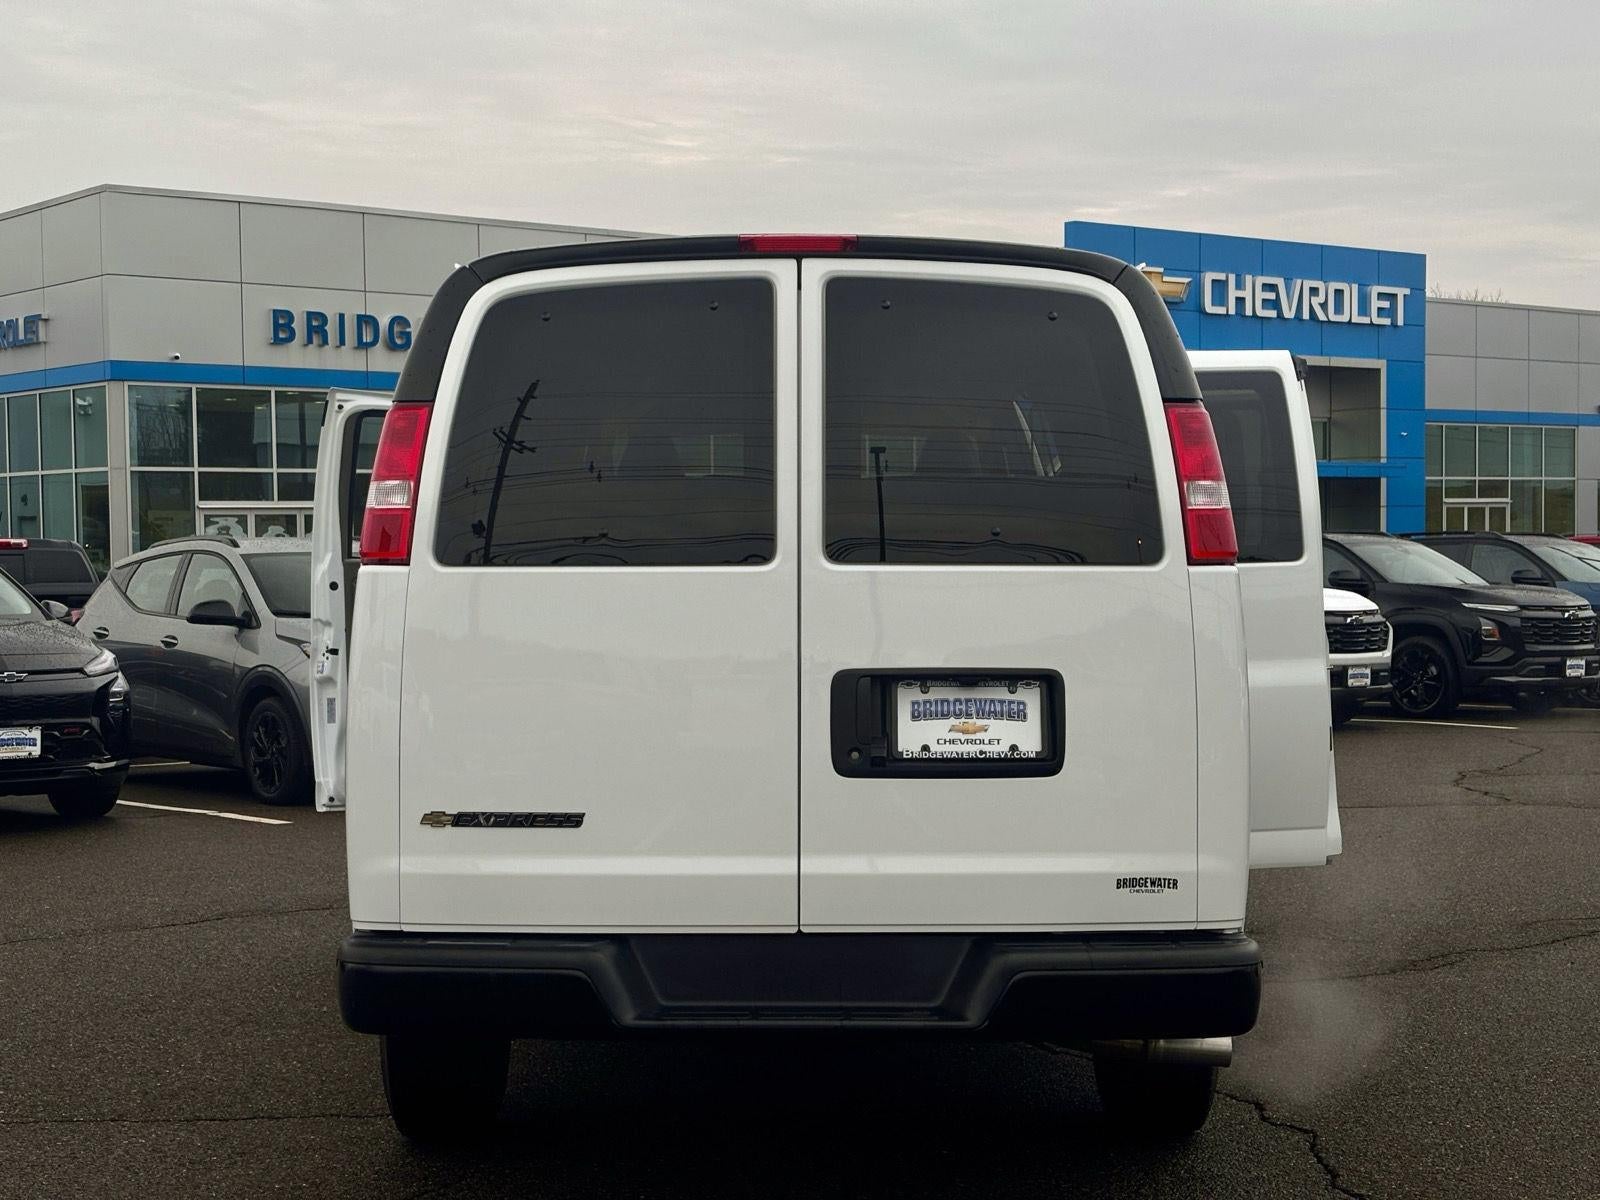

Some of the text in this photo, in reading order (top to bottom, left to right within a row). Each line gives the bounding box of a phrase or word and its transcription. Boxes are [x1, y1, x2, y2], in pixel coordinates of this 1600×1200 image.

[1203, 272, 1411, 326] CHEVROLET
[910, 698, 1028, 722] BRIDGEWATER
[936, 737, 1001, 746] CHEVROLET
[452, 812, 585, 828] EXPRESS
[1116, 877, 1178, 890] BRIDGEWATER
